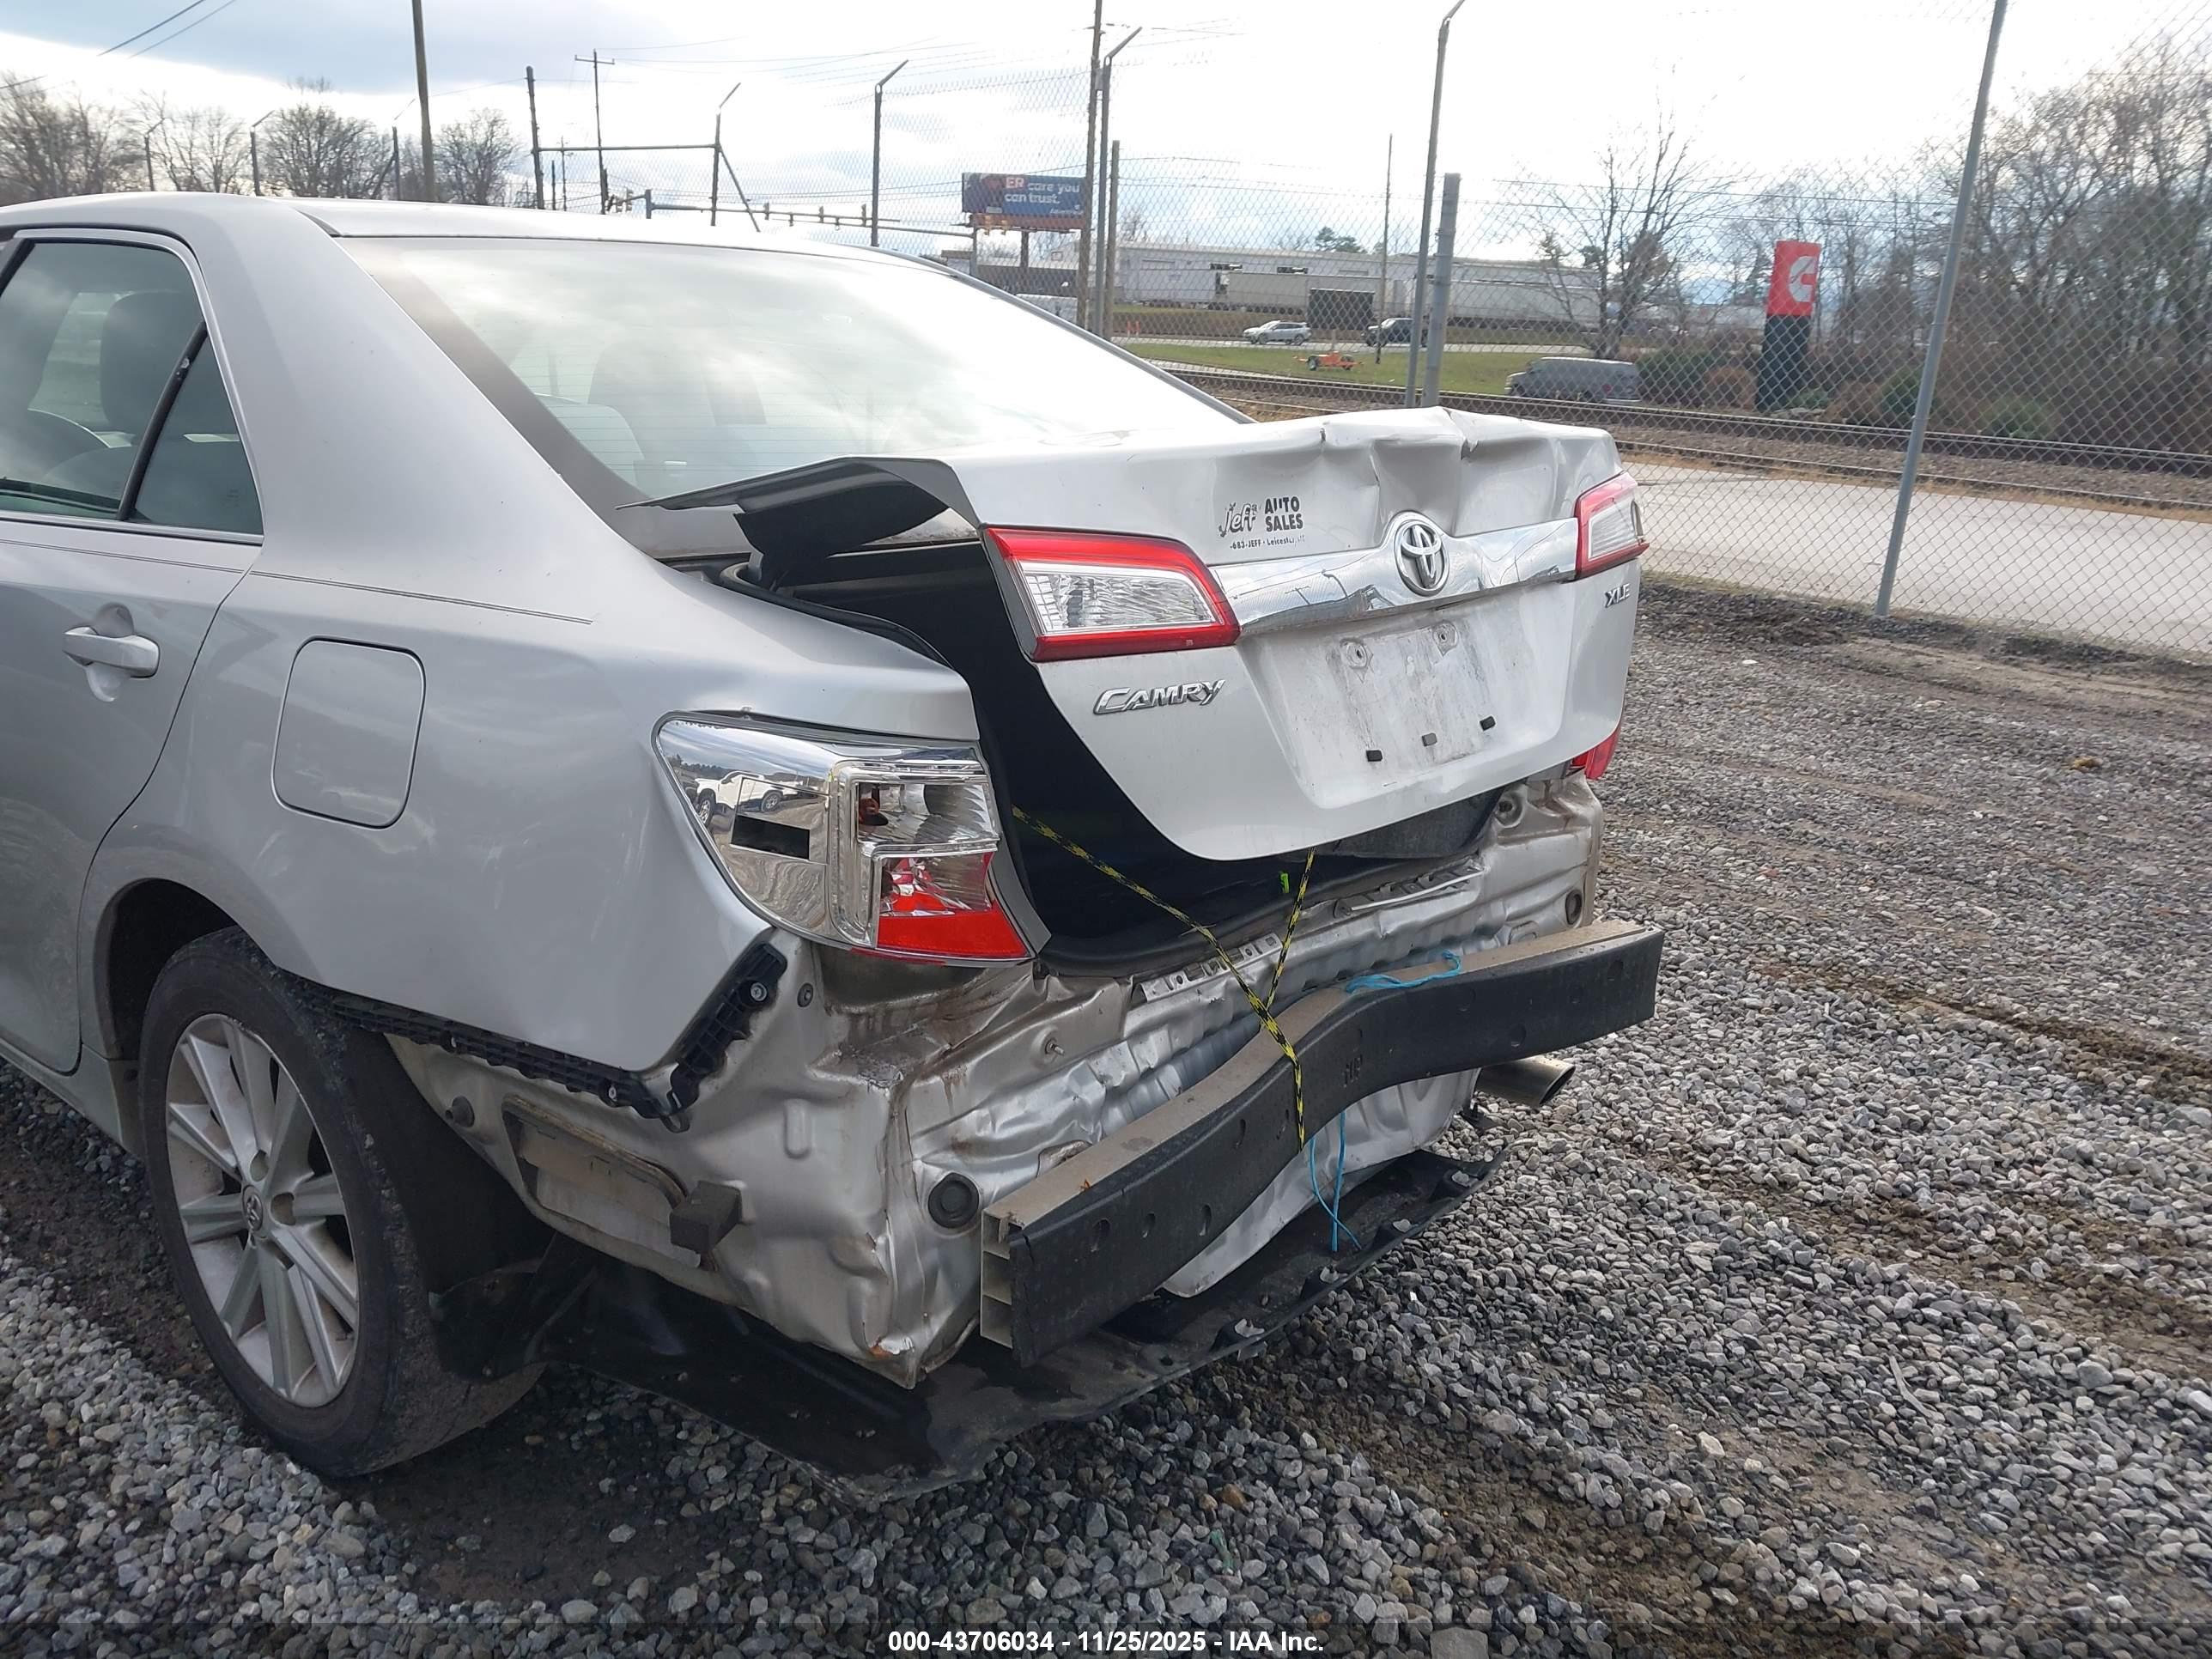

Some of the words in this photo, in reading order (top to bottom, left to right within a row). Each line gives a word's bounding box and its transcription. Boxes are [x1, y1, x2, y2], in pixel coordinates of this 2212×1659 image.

[1005, 177, 1024, 189] ER
[1028, 182, 1054, 192] care
[1058, 183, 1080, 195] you
[1004, 194, 1027, 203] can
[1264, 495, 1300, 515] AUTO
[1265, 514, 1304, 532] SALES
[1604, 583, 1631, 608] XLE
[1093, 679, 1226, 714] CAMRY
